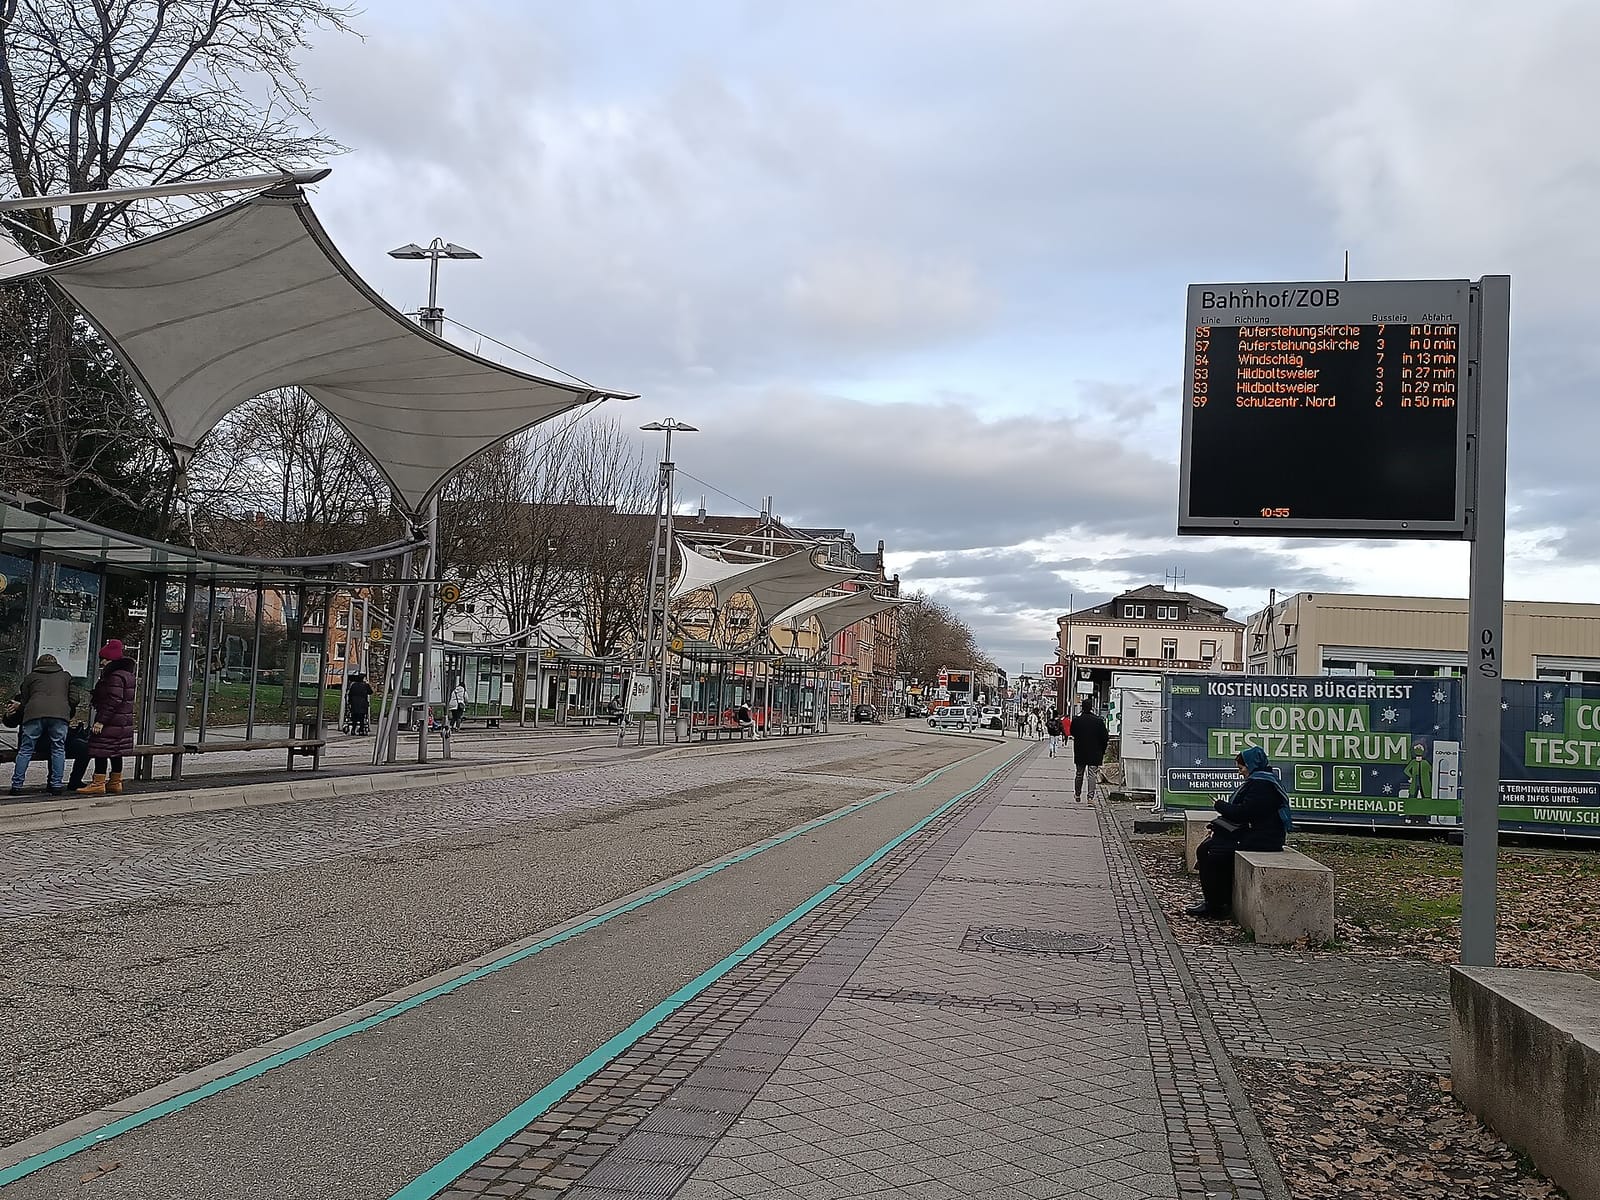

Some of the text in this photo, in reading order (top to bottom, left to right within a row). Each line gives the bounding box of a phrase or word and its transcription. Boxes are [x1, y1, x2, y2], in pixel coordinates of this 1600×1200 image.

[1202, 289, 1339, 308] Bahnhof/ZOB
[1235, 316, 1270, 325] Richtung
[1372, 314, 1408, 322] Bussteig
[1422, 313, 1453, 321] Abfahrt
[1196, 324, 1456, 339] S5 Auferstehungskirche 7 in 0 min
[1195, 338, 1456, 353] S7 Auferstehungskirche 3 in 0 min
[1195, 352, 1456, 368] S4 Windschläg 7 in 13 min
[1194, 367, 1455, 380] S3 Hildboltsweier 3 in 27 min
[1193, 381, 1455, 394] S3 Hildboltsweier 3 in 29 min
[1192, 395, 1455, 408] S9 Schulzentr. Nord 6 in 50 min
[1260, 507, 1290, 517] 10:55
[444, 587, 455, 600] 6
[1046, 666, 1062, 676] DB
[1208, 681, 1413, 699] KOSTENLOSER BÜRGERTEST
[1255, 706, 1365, 732] CORONA
[1212, 732, 1407, 760] TESTZENTRUM
[1530, 738, 1600, 766] TEST
[1172, 772, 1191, 780] OHNE
[1507, 785, 1597, 794] TERMINVEREINBARUNG!
[1502, 794, 1579, 803] MEHR INFOS UNTER:
